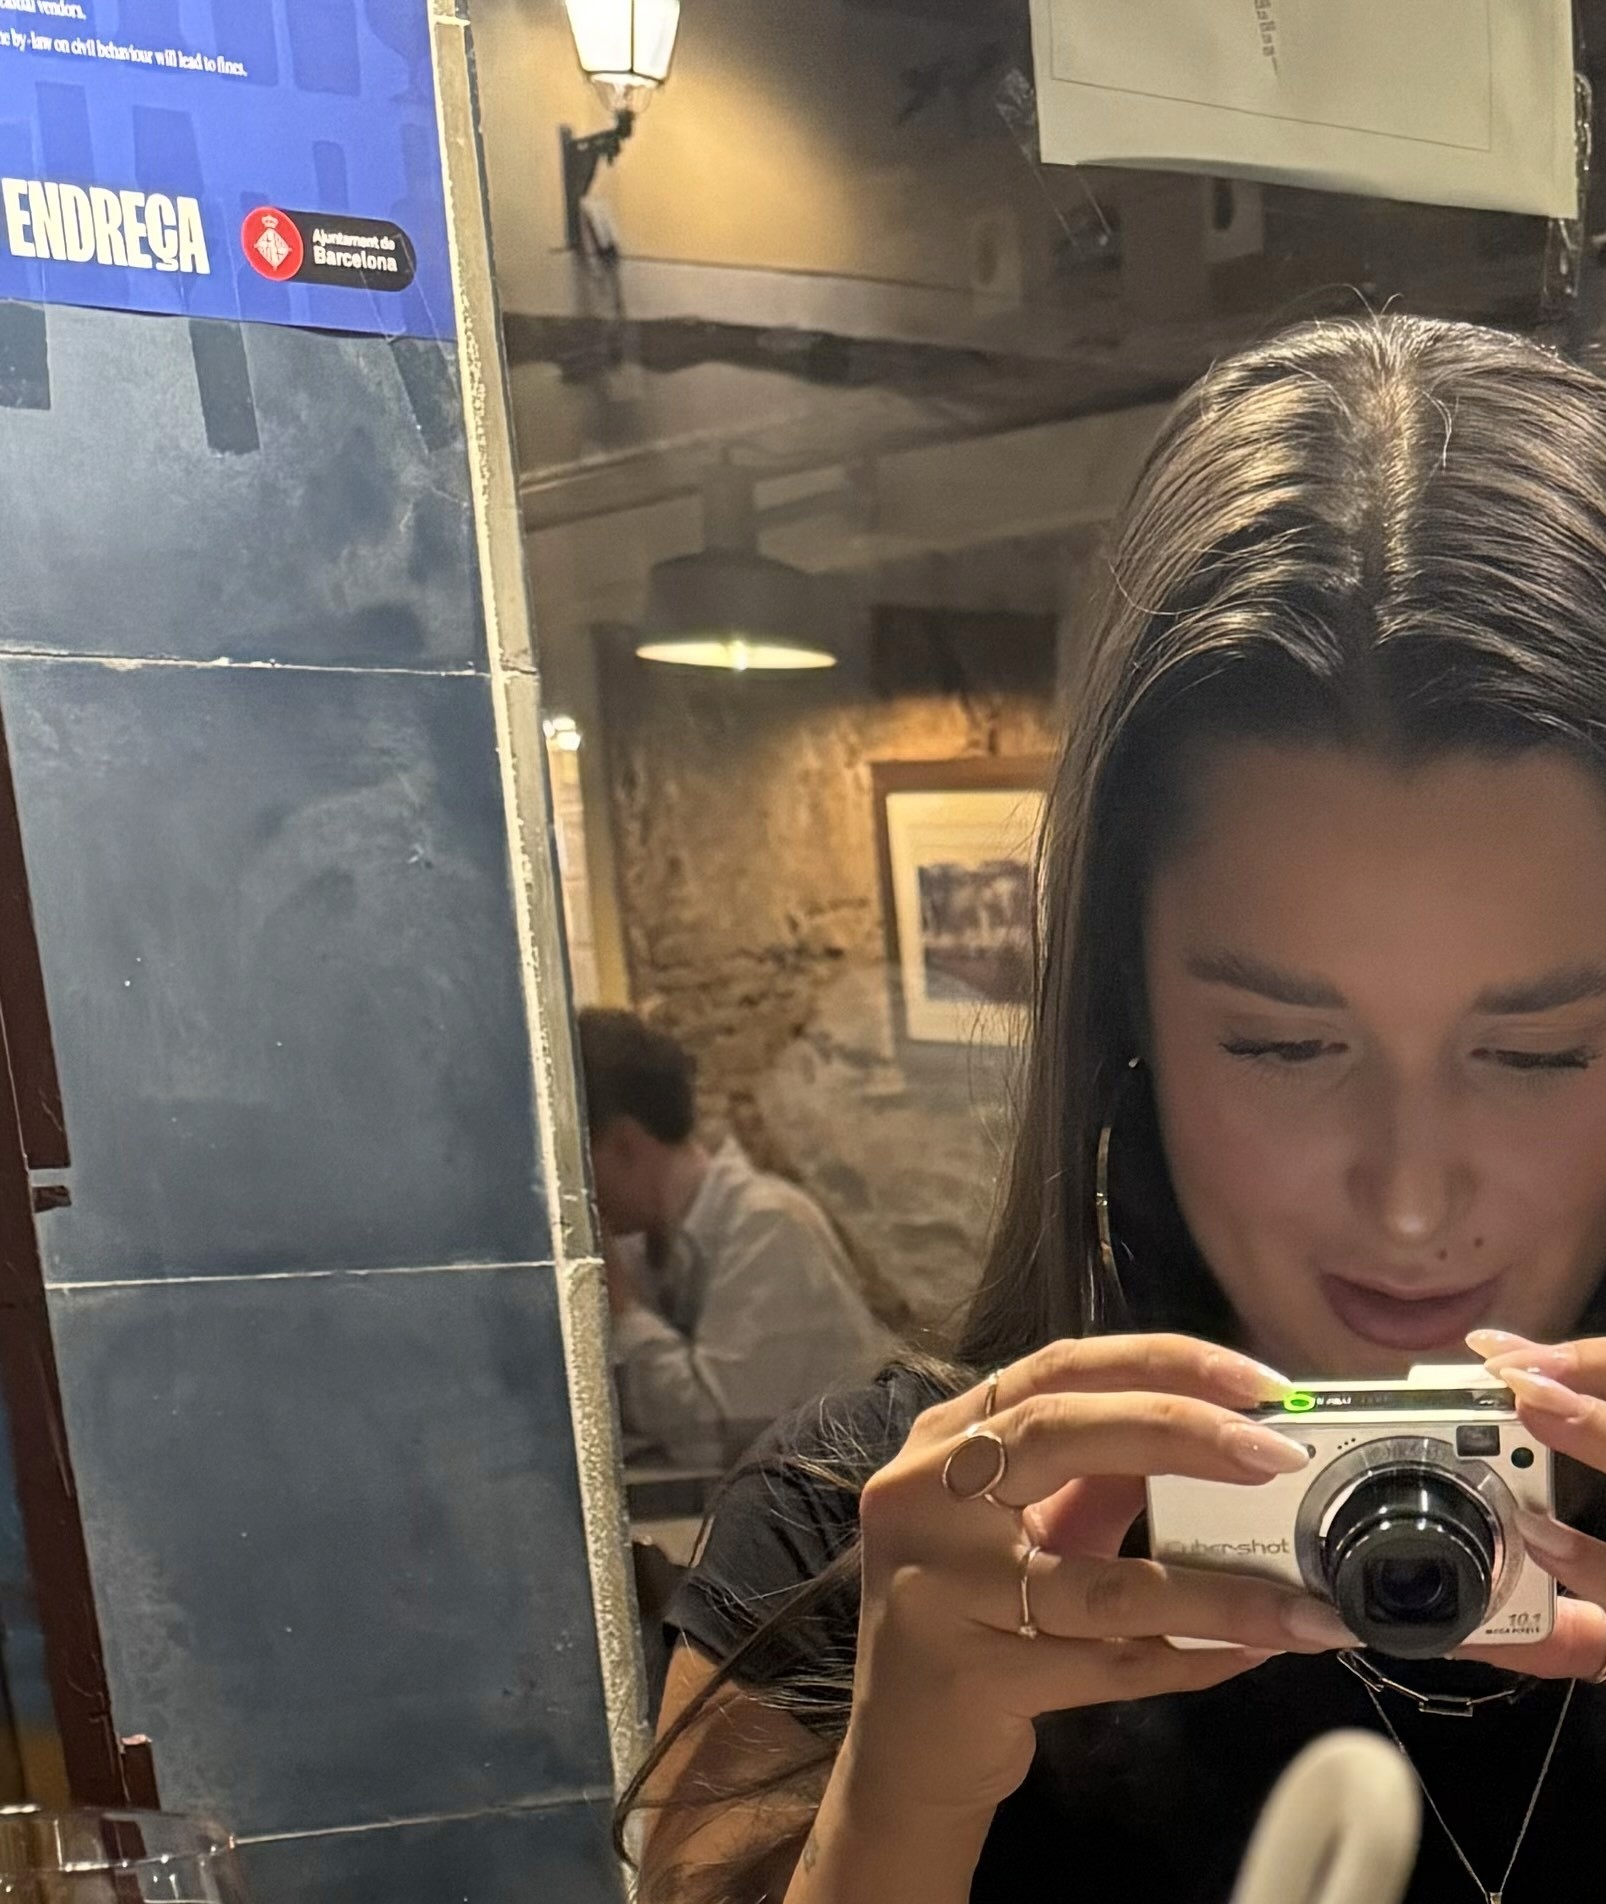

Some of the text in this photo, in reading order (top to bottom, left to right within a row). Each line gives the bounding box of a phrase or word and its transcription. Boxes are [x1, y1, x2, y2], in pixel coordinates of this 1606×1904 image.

[53, 38, 71, 54] on
[154, 48, 178, 69] will
[177, 50, 204, 72] lead
[203, 55, 217, 73] to
[2, 178, 211, 275] ENDREÇA
[313, 245, 398, 273] Barcelona
